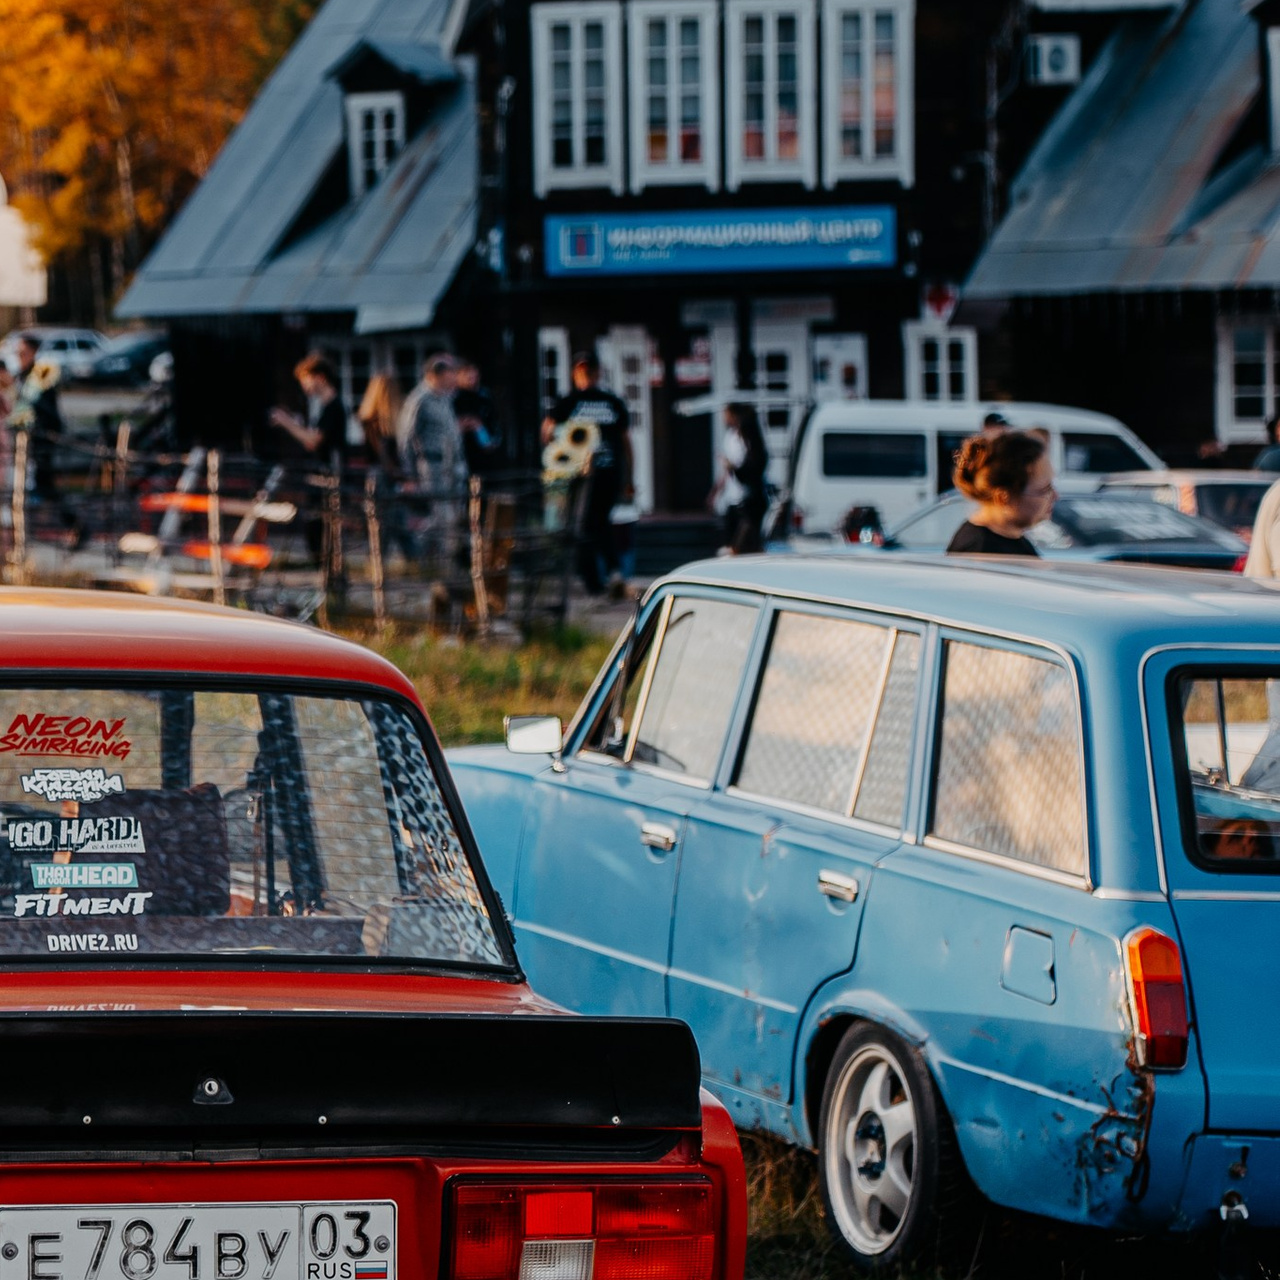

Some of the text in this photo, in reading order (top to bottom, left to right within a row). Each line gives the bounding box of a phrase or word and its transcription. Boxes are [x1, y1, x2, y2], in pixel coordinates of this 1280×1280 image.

[7, 713, 126, 741] NEON
[59, 817, 139, 844] HARD!
[36, 866, 72, 878] THAT
[71, 866, 133, 885] HEAD
[47, 934, 138, 951] DRIVE2.RU
[308, 1211, 371, 1260] 03
[307, 1262, 353, 1280] RUS
